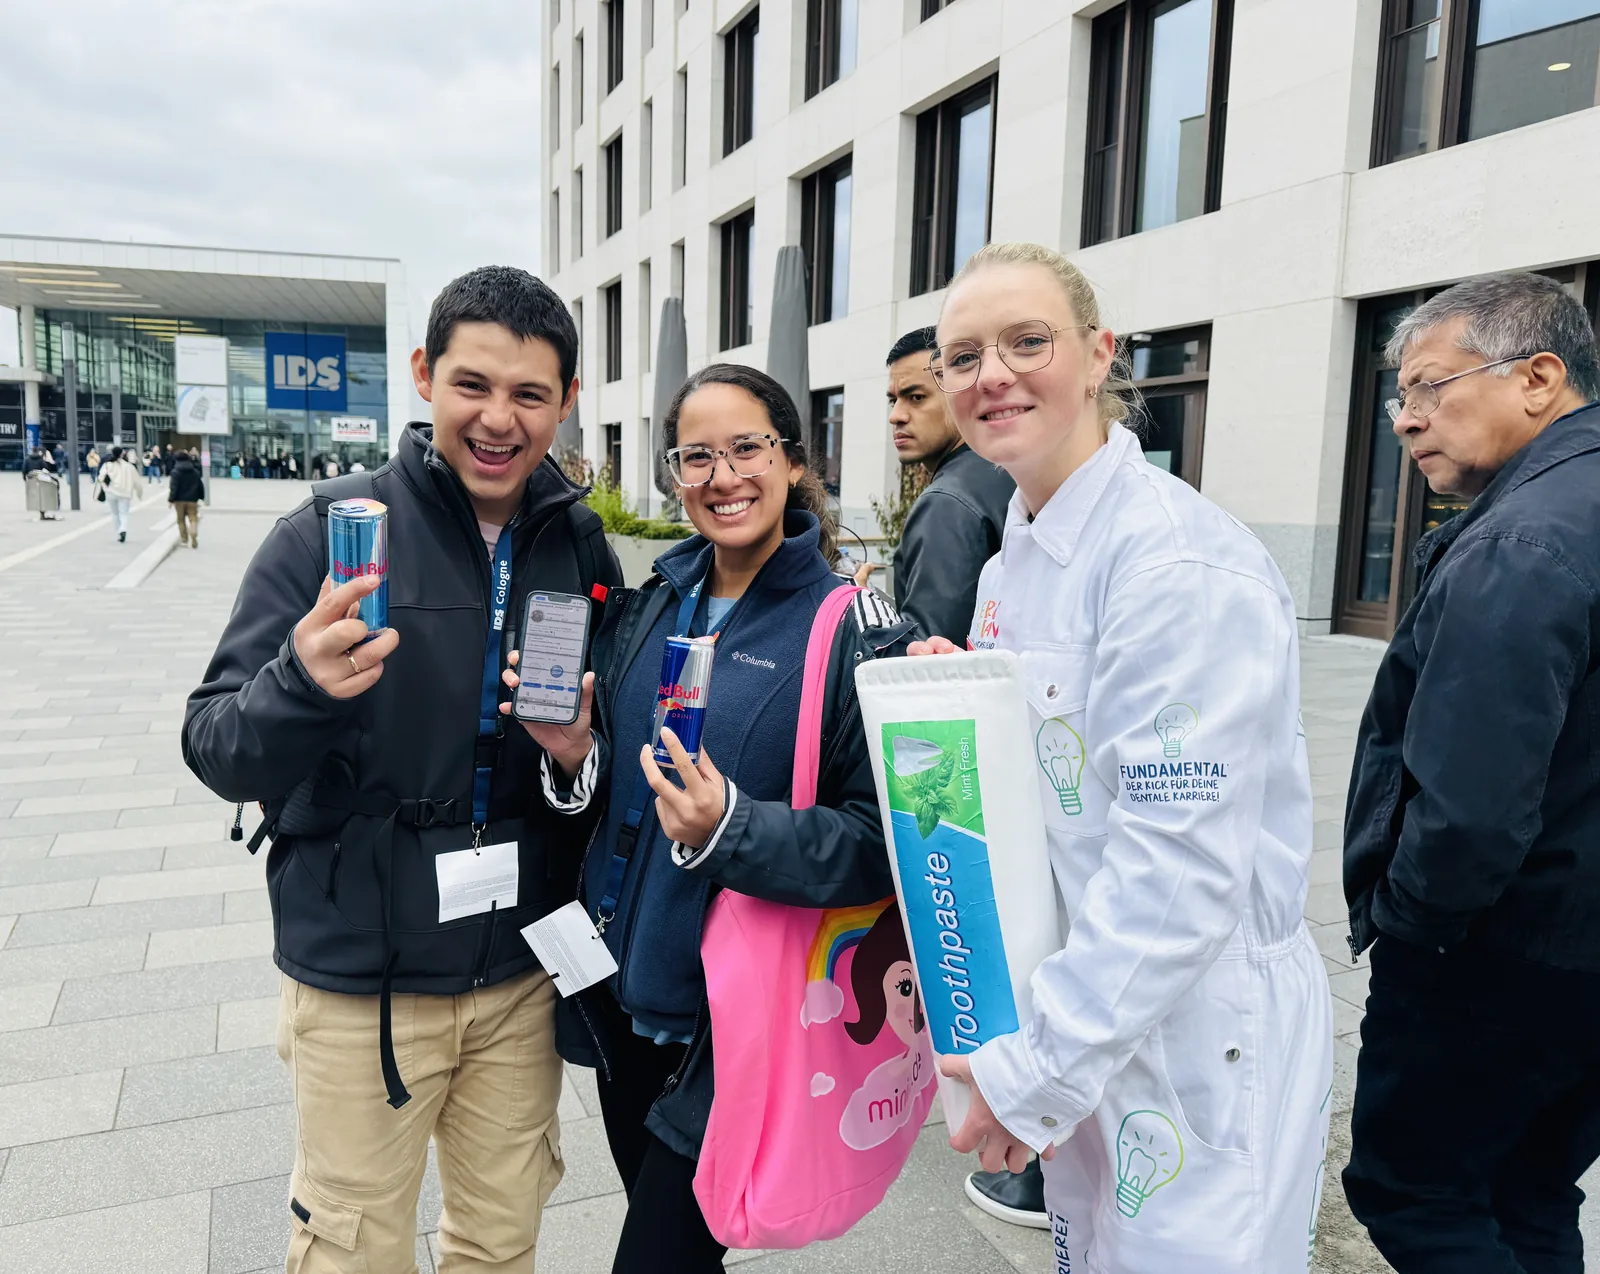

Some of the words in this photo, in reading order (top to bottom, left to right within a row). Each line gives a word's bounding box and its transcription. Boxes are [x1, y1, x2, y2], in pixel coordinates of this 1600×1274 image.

[273, 354, 341, 388] IDS
[334, 559, 364, 577] Red
[367, 557, 389, 576] Bul
[496, 560, 511, 605] Cologne
[493, 608, 504, 631] IDS
[739, 653, 776, 669] Columbia
[658, 682, 673, 697] ed
[673, 684, 700, 700] Bull
[671, 712, 693, 720] DRINK
[959, 736, 970, 771] Fresh
[1119, 762, 1227, 779] FUNDAMENTAL
[961, 773, 973, 800] Mint
[1126, 781, 1143, 791] DER
[1145, 780, 1169, 790] KICK
[1170, 777, 1190, 790] FÜR
[1192, 778, 1219, 790] DEINE
[1130, 792, 1170, 803] DENTALE
[1172, 791, 1220, 802] KARRIERE!
[924, 851, 982, 1050] Toothpaste
